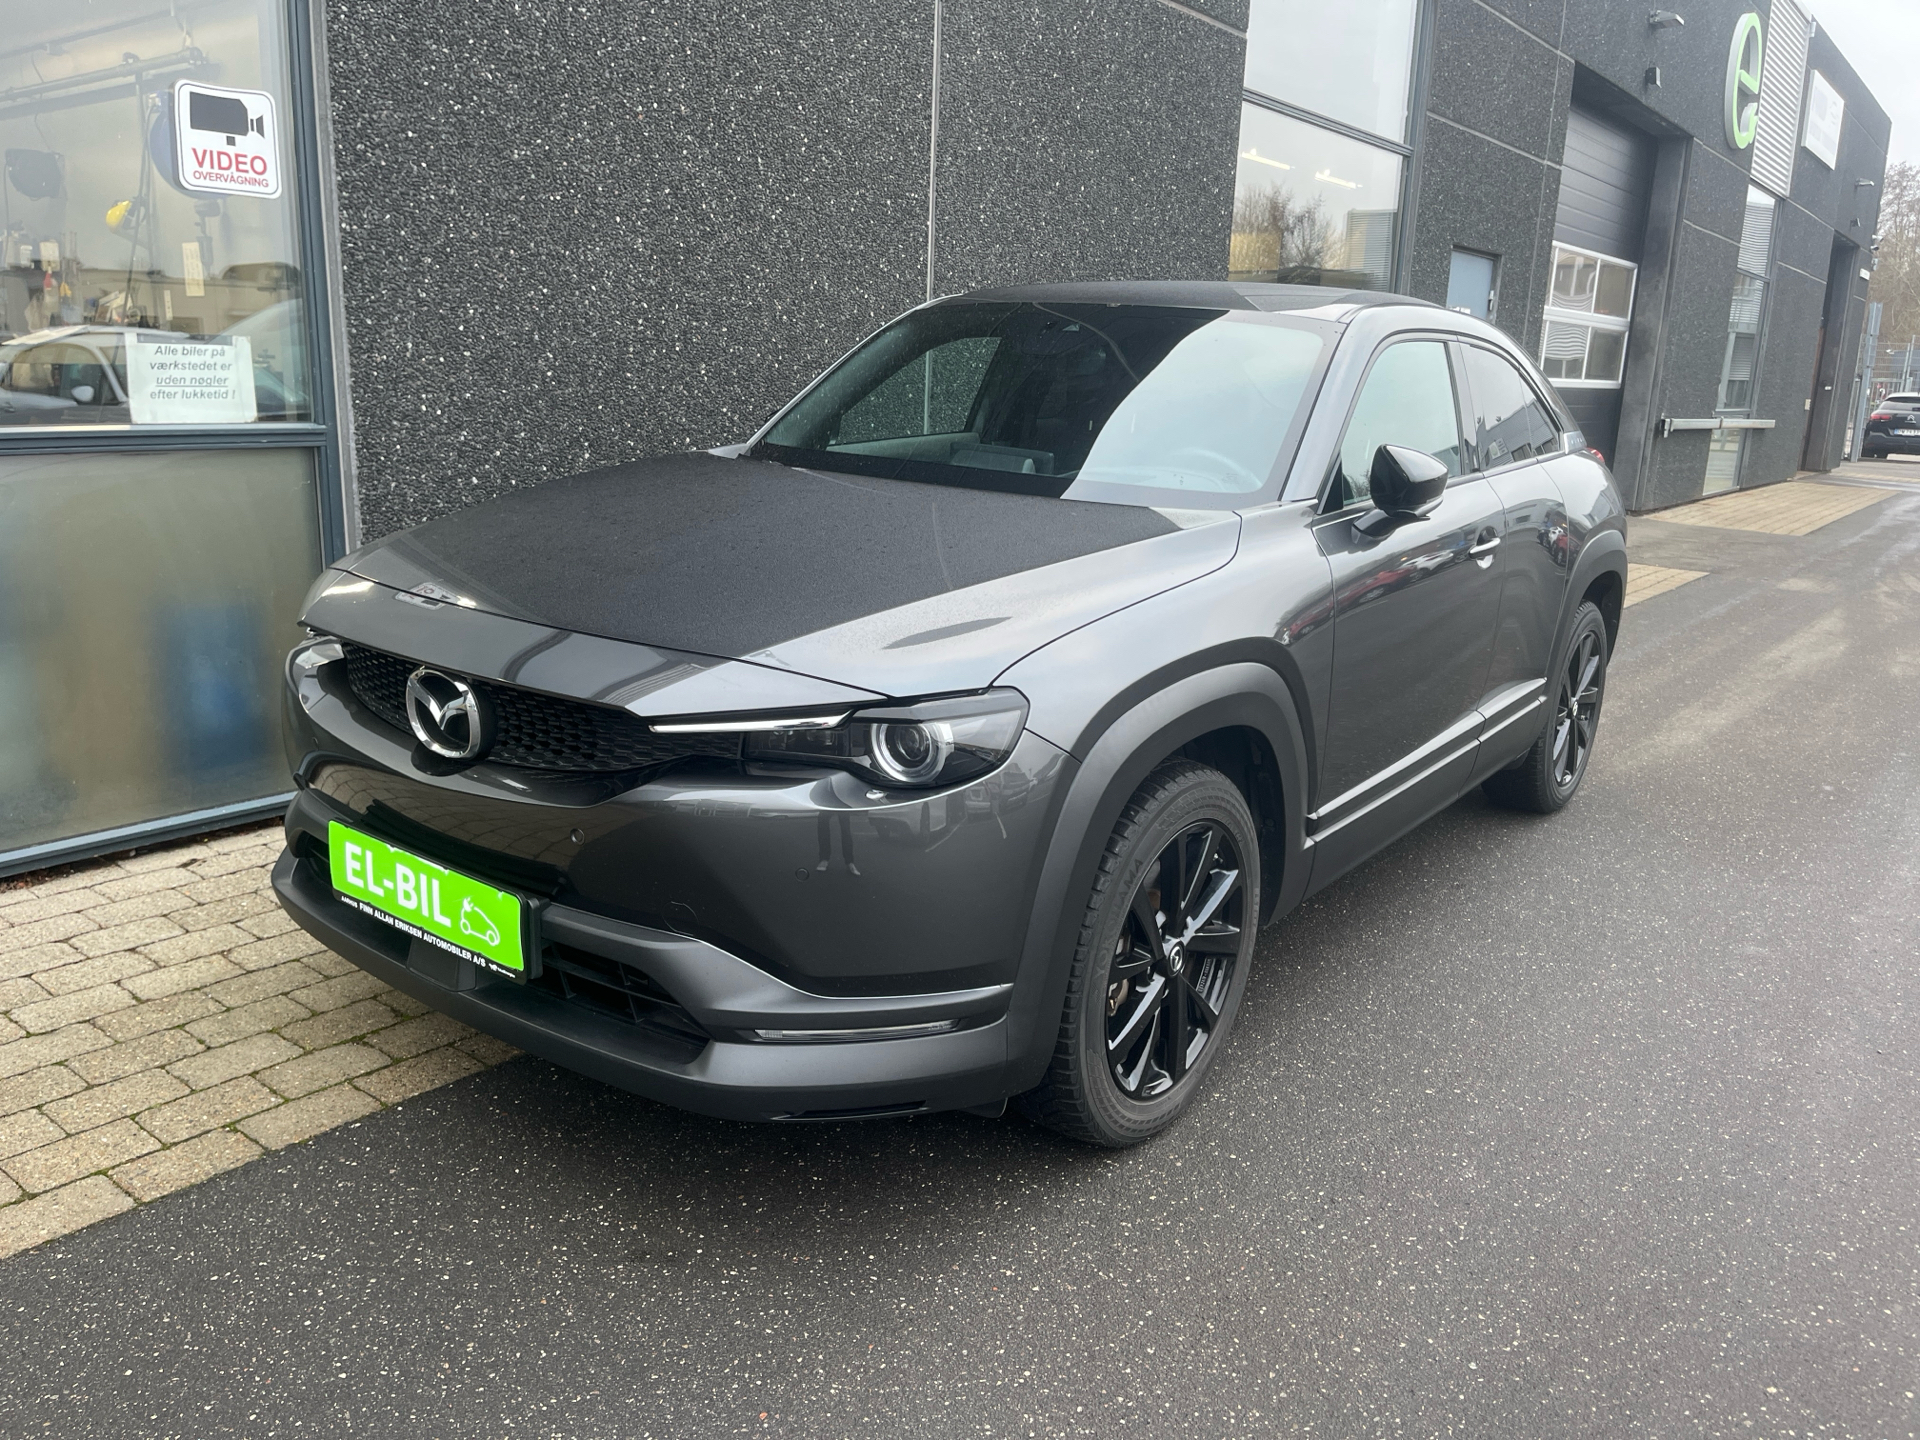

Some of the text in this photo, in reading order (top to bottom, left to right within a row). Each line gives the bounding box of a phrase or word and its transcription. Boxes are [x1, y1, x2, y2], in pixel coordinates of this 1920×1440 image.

[191, 147, 267, 176] VIDEO
[193, 170, 269, 188] OVERVÅGNING
[154, 345, 226, 359] Alle biler på
[149, 361, 232, 371] værkstedet er
[156, 375, 229, 387] uden nøgler
[150, 390, 178, 399] efter
[181, 390, 229, 400] lukketid
[345, 841, 452, 929] EL-BIL
[359, 902, 373, 916] FINN
[374, 909, 394, 925] ALLAN
[395, 918, 422, 939] ERIKSEN
[423, 932, 472, 961] AUTOMOBILER
[473, 954, 486, 967] A/S
